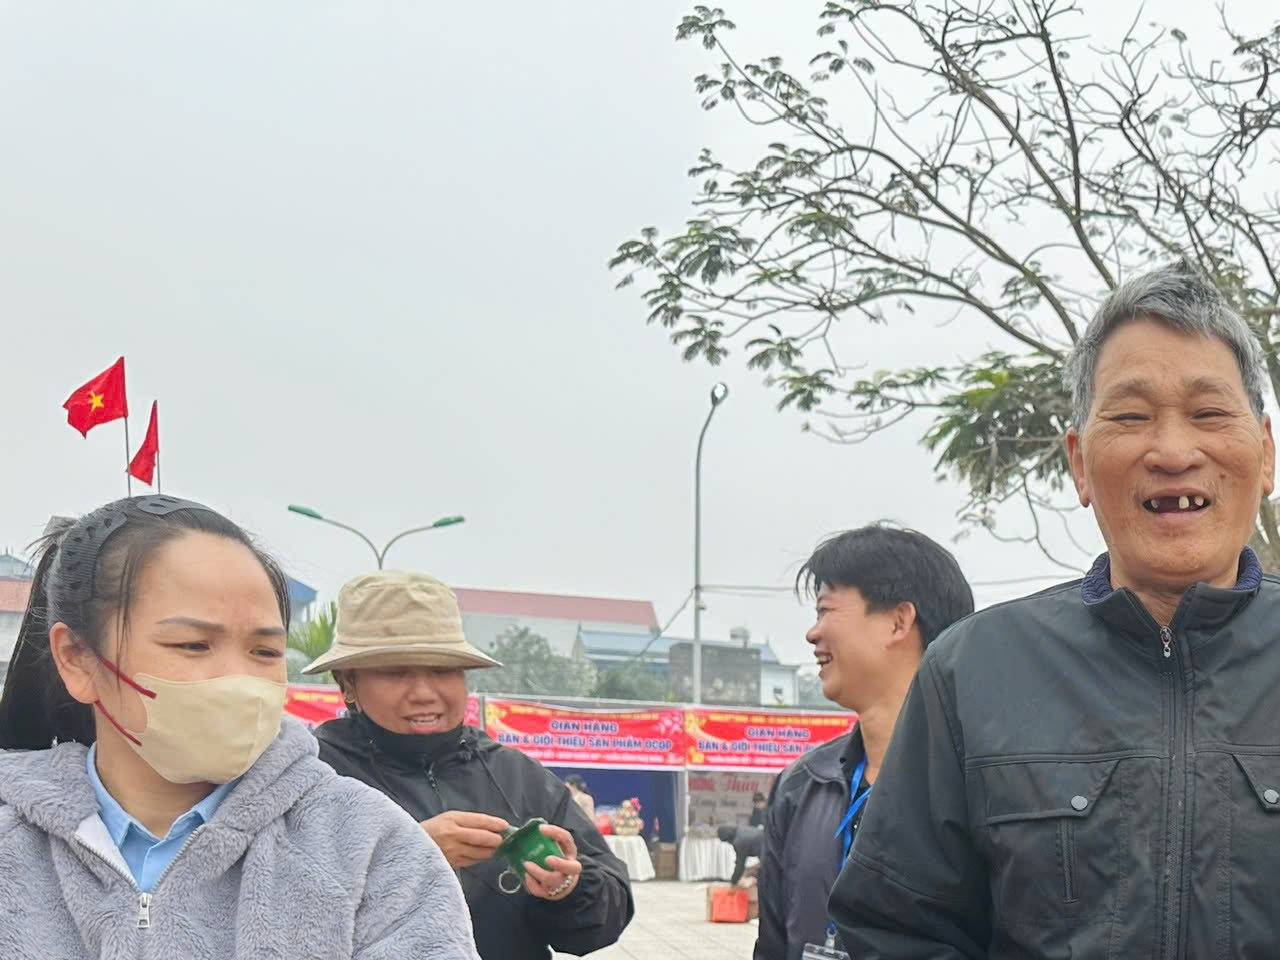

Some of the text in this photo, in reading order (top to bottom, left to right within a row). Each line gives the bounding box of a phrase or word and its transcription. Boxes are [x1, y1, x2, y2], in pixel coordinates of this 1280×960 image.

[551, 719, 618, 732] GIAN HÀNG
[748, 728, 775, 738] GIAN
